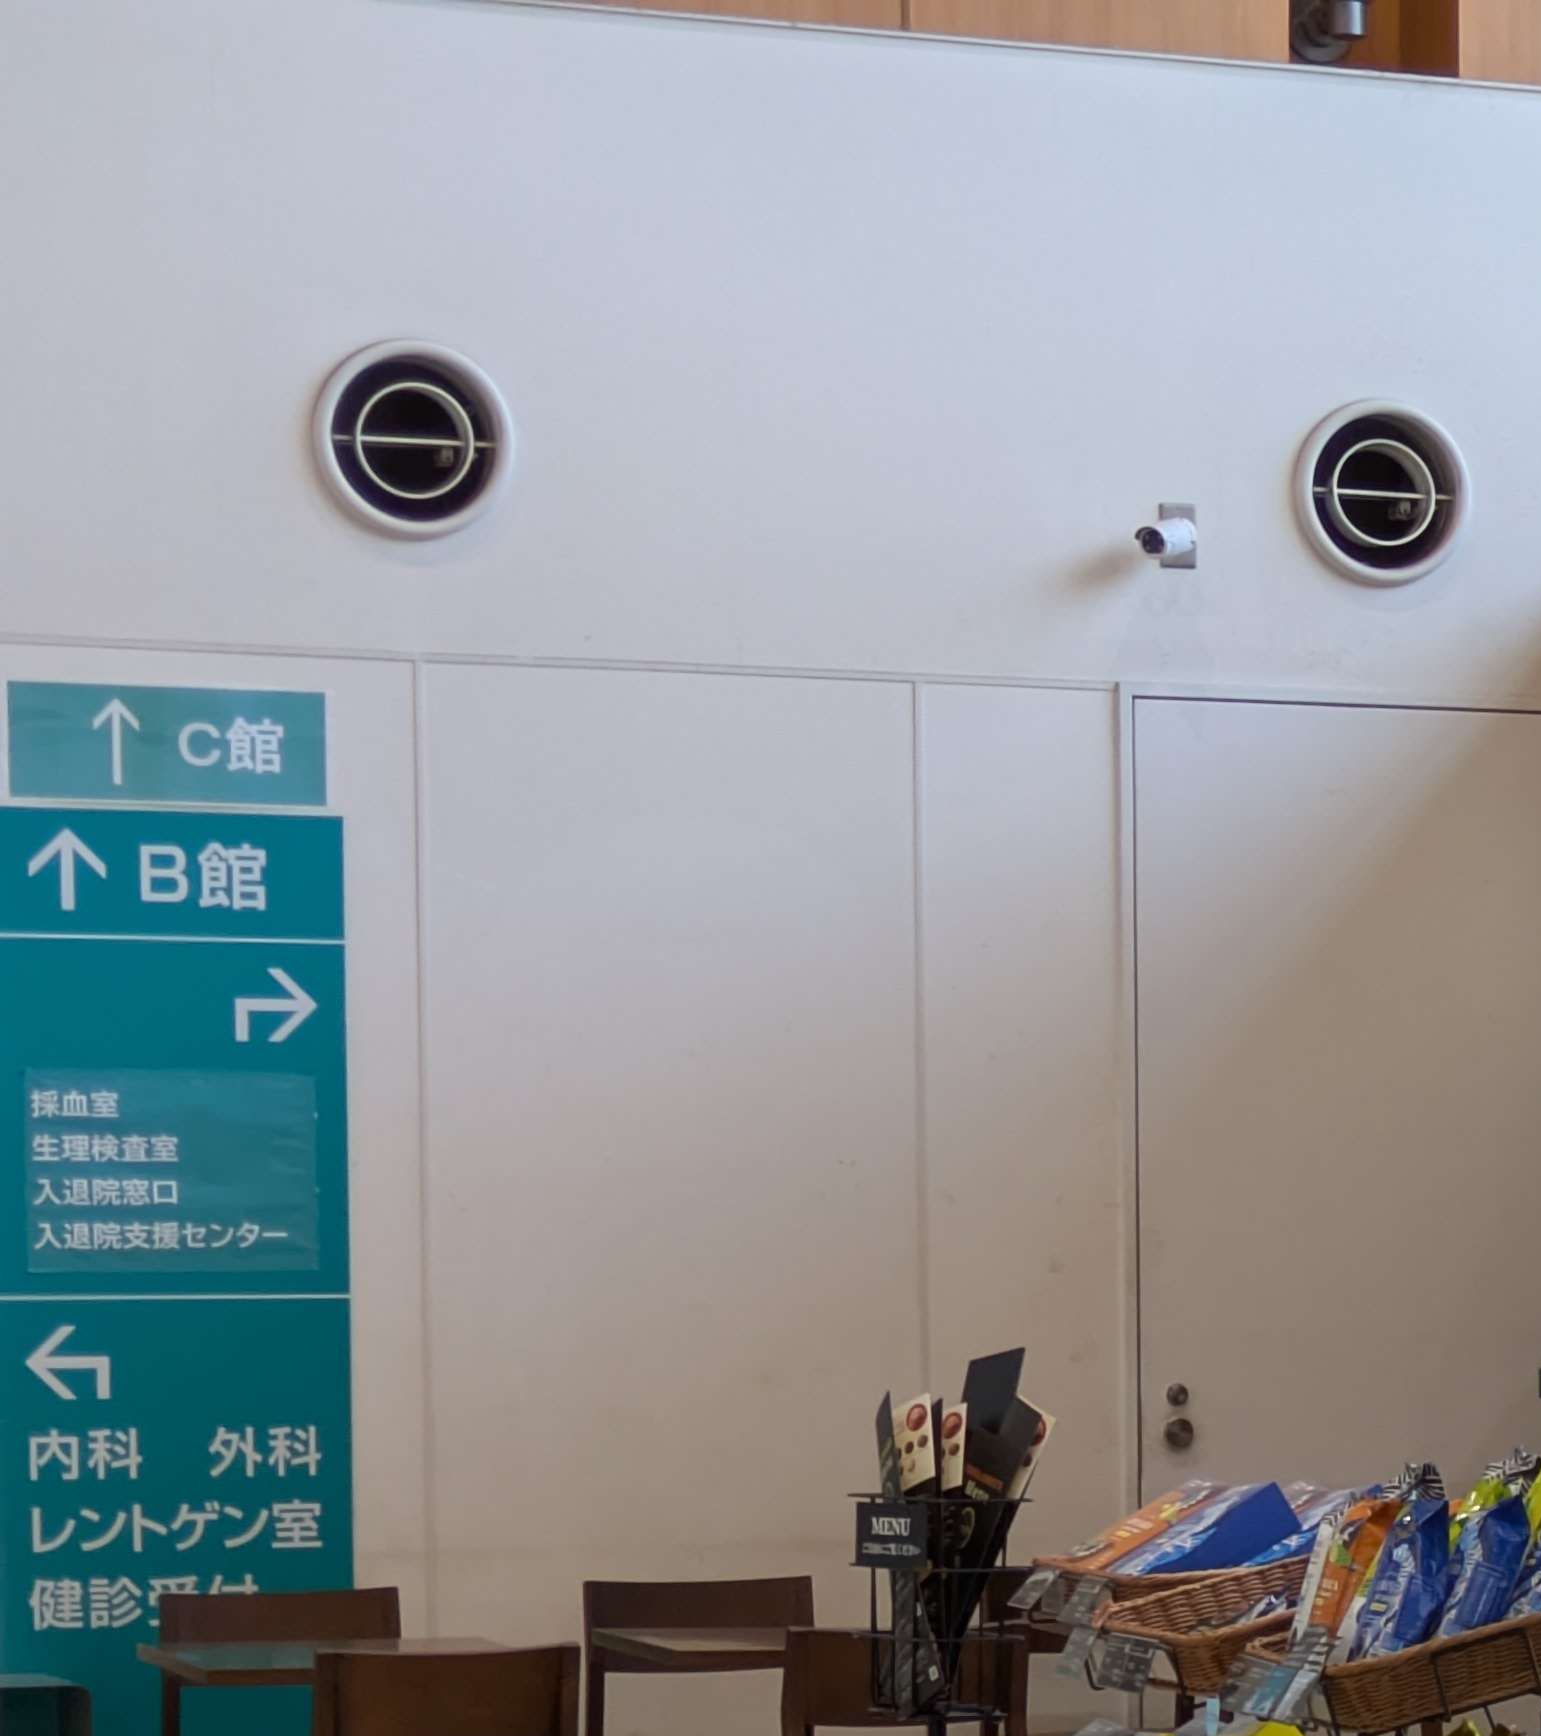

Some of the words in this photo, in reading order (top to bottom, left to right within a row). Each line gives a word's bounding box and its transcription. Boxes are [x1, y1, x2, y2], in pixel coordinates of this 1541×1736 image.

[178, 718, 284, 774] C館
[138, 842, 267, 912] B館
[30, 1090, 120, 1118] 採血室
[31, 1135, 179, 1162] 生理検査室
[33, 1179, 178, 1205] 入退院窓口
[34, 1223, 288, 1250] 入退院支援センター
[29, 1428, 143, 1480] 内科
[208, 1426, 321, 1477] 外科
[31, 1499, 322, 1553] レントゲン室
[872, 1517, 911, 1536] MENU
